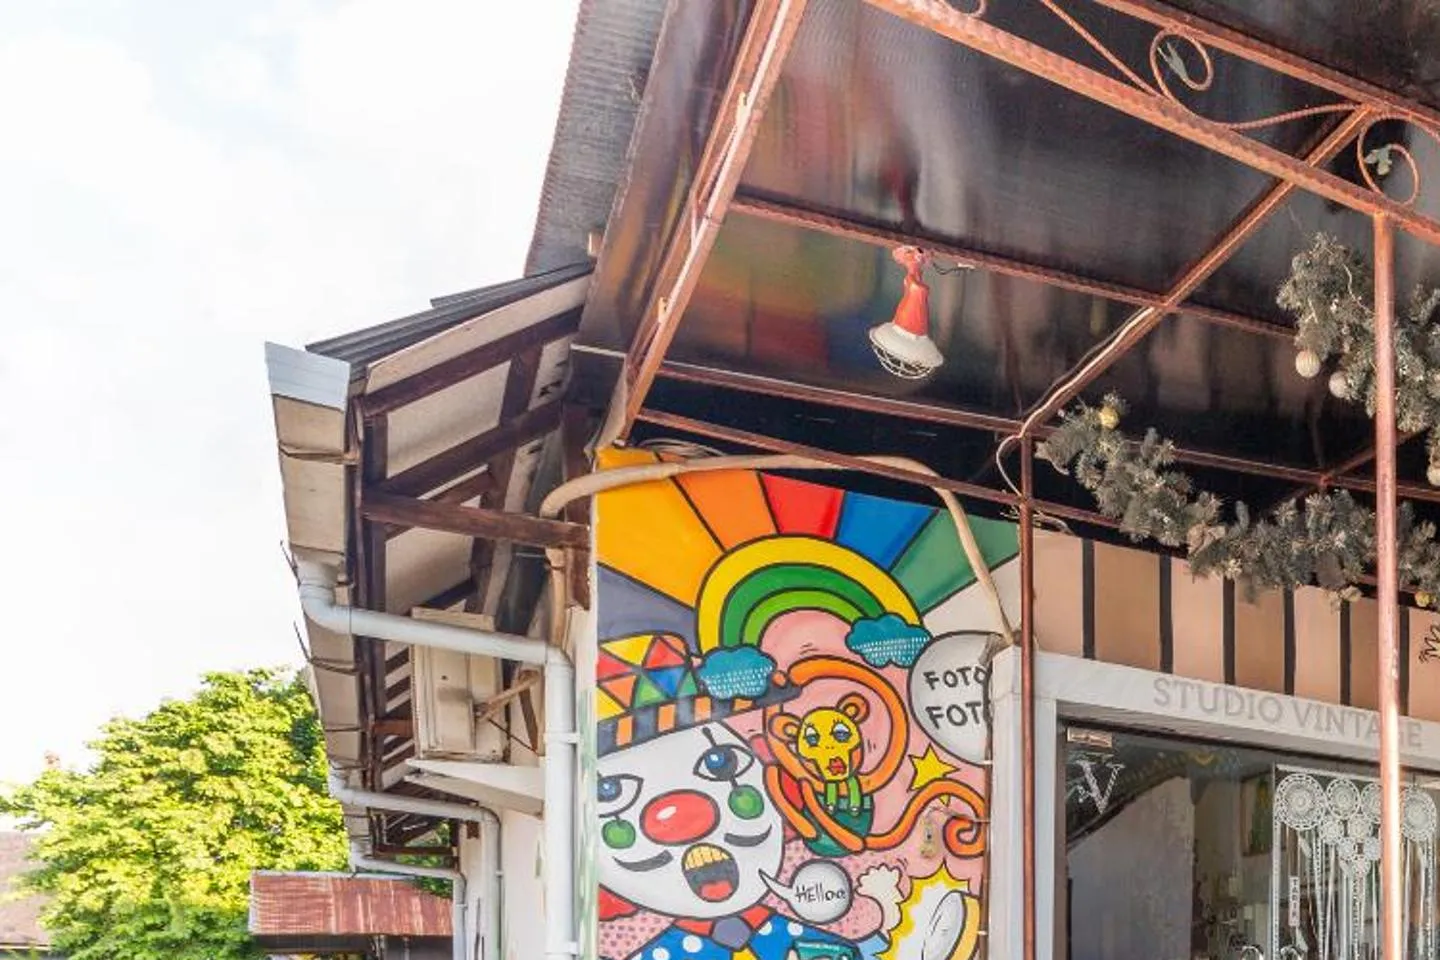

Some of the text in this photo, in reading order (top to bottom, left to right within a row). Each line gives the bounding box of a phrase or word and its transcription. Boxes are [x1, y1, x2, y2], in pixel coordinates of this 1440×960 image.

[925, 701, 982, 730] FOT
[1152, 677, 1423, 748] STUDIO VINTAE
